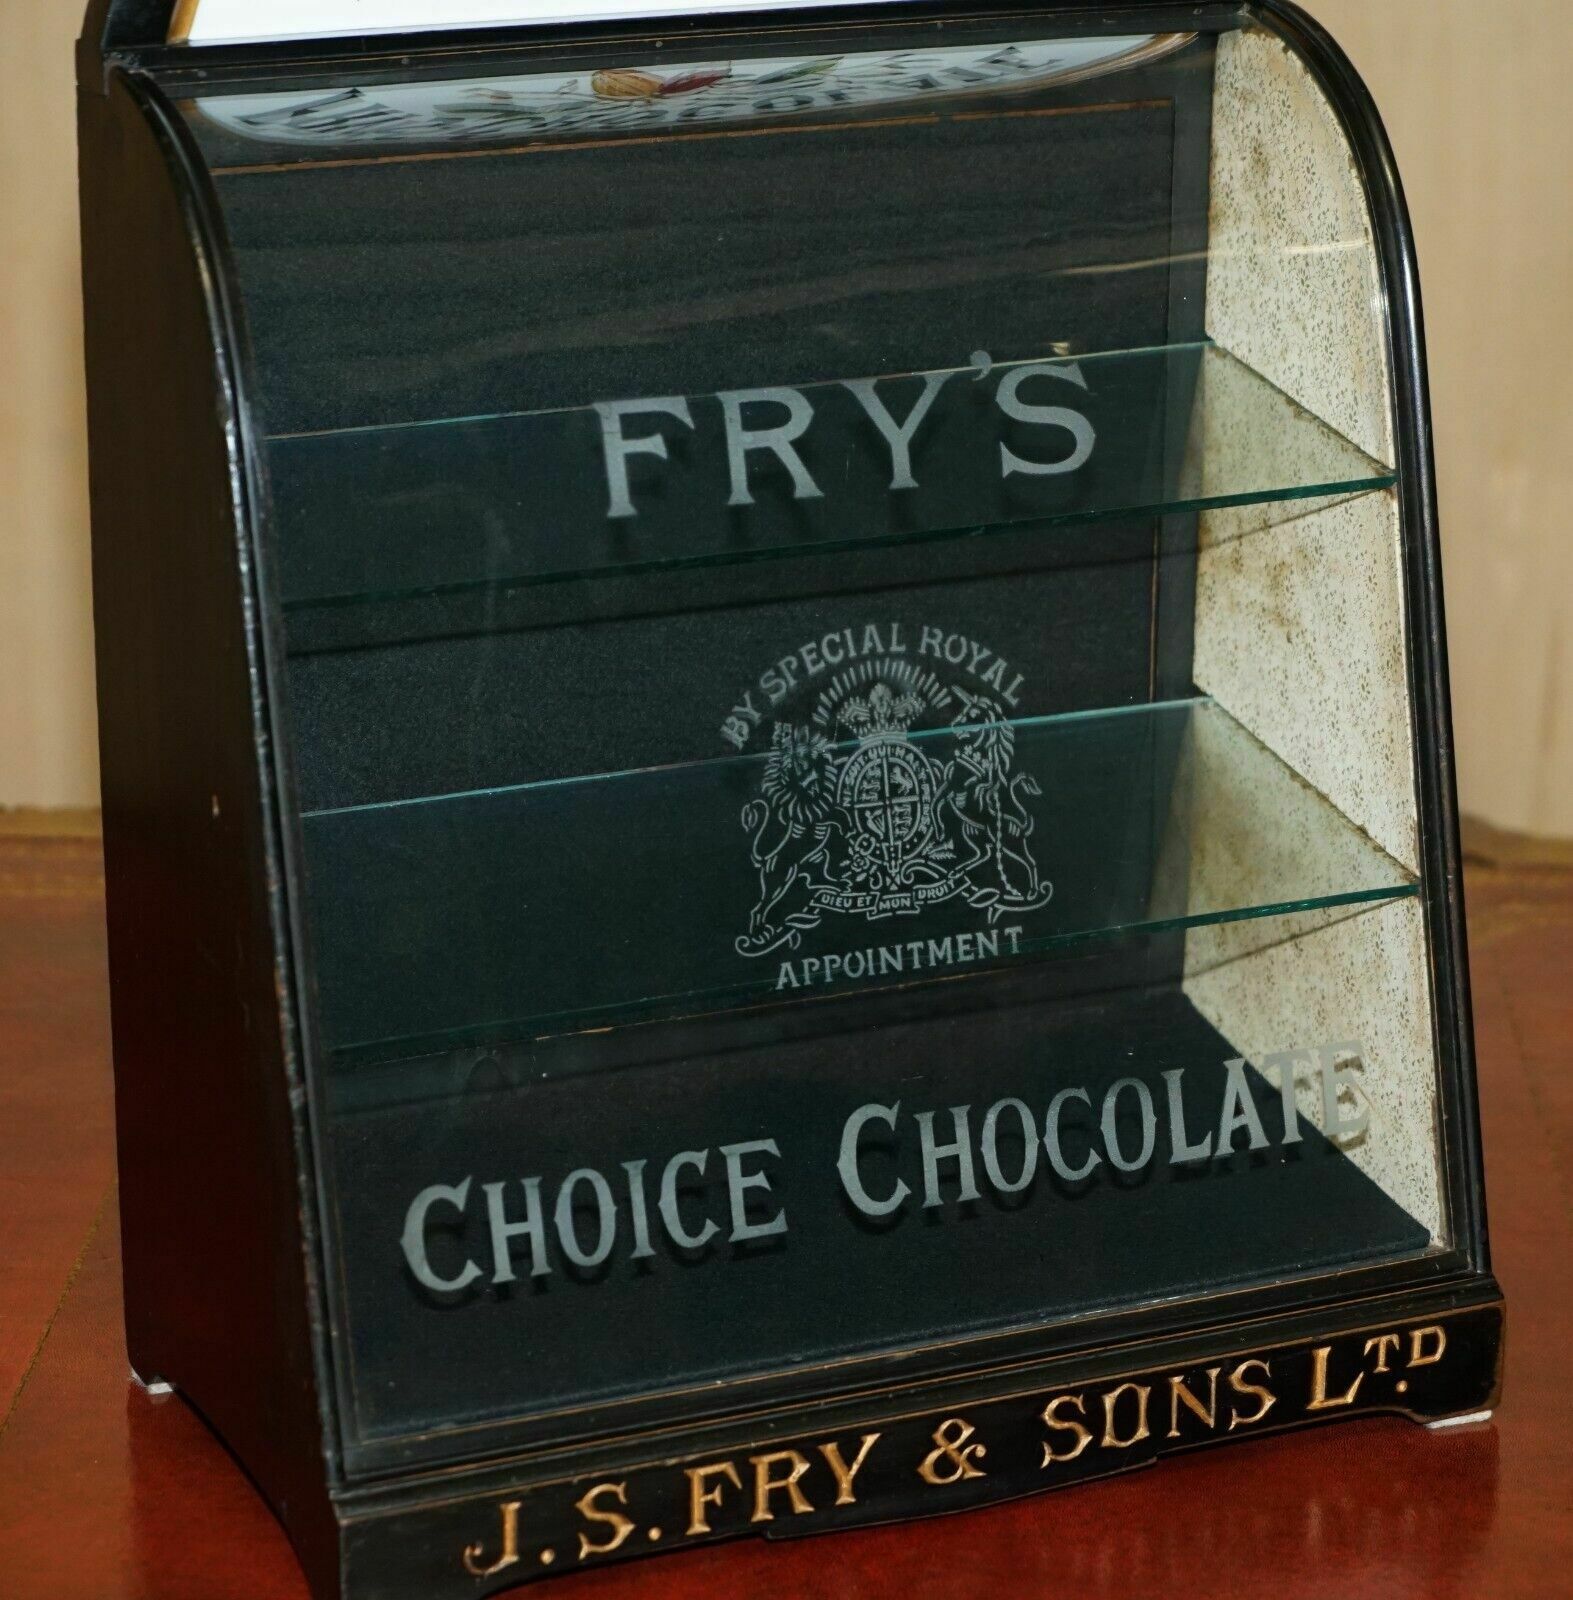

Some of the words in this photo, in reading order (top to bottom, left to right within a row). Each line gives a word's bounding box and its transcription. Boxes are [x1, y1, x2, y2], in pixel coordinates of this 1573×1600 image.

[593, 350, 1095, 518] FRY'S
[720, 691, 762, 750] BY
[760, 623, 906, 702] SPECIAL
[920, 626, 1026, 707] ROYAL
[775, 926, 1023, 990] APPOINTMENT
[857, 896, 873, 908] ET
[400, 1138, 789, 1292] CHOICE
[837, 1040, 1370, 1216] CHOCOLATE
[683, 1432, 882, 1536] FRY
[917, 1418, 988, 1485] &
[1040, 1359, 1277, 1469] SONS
